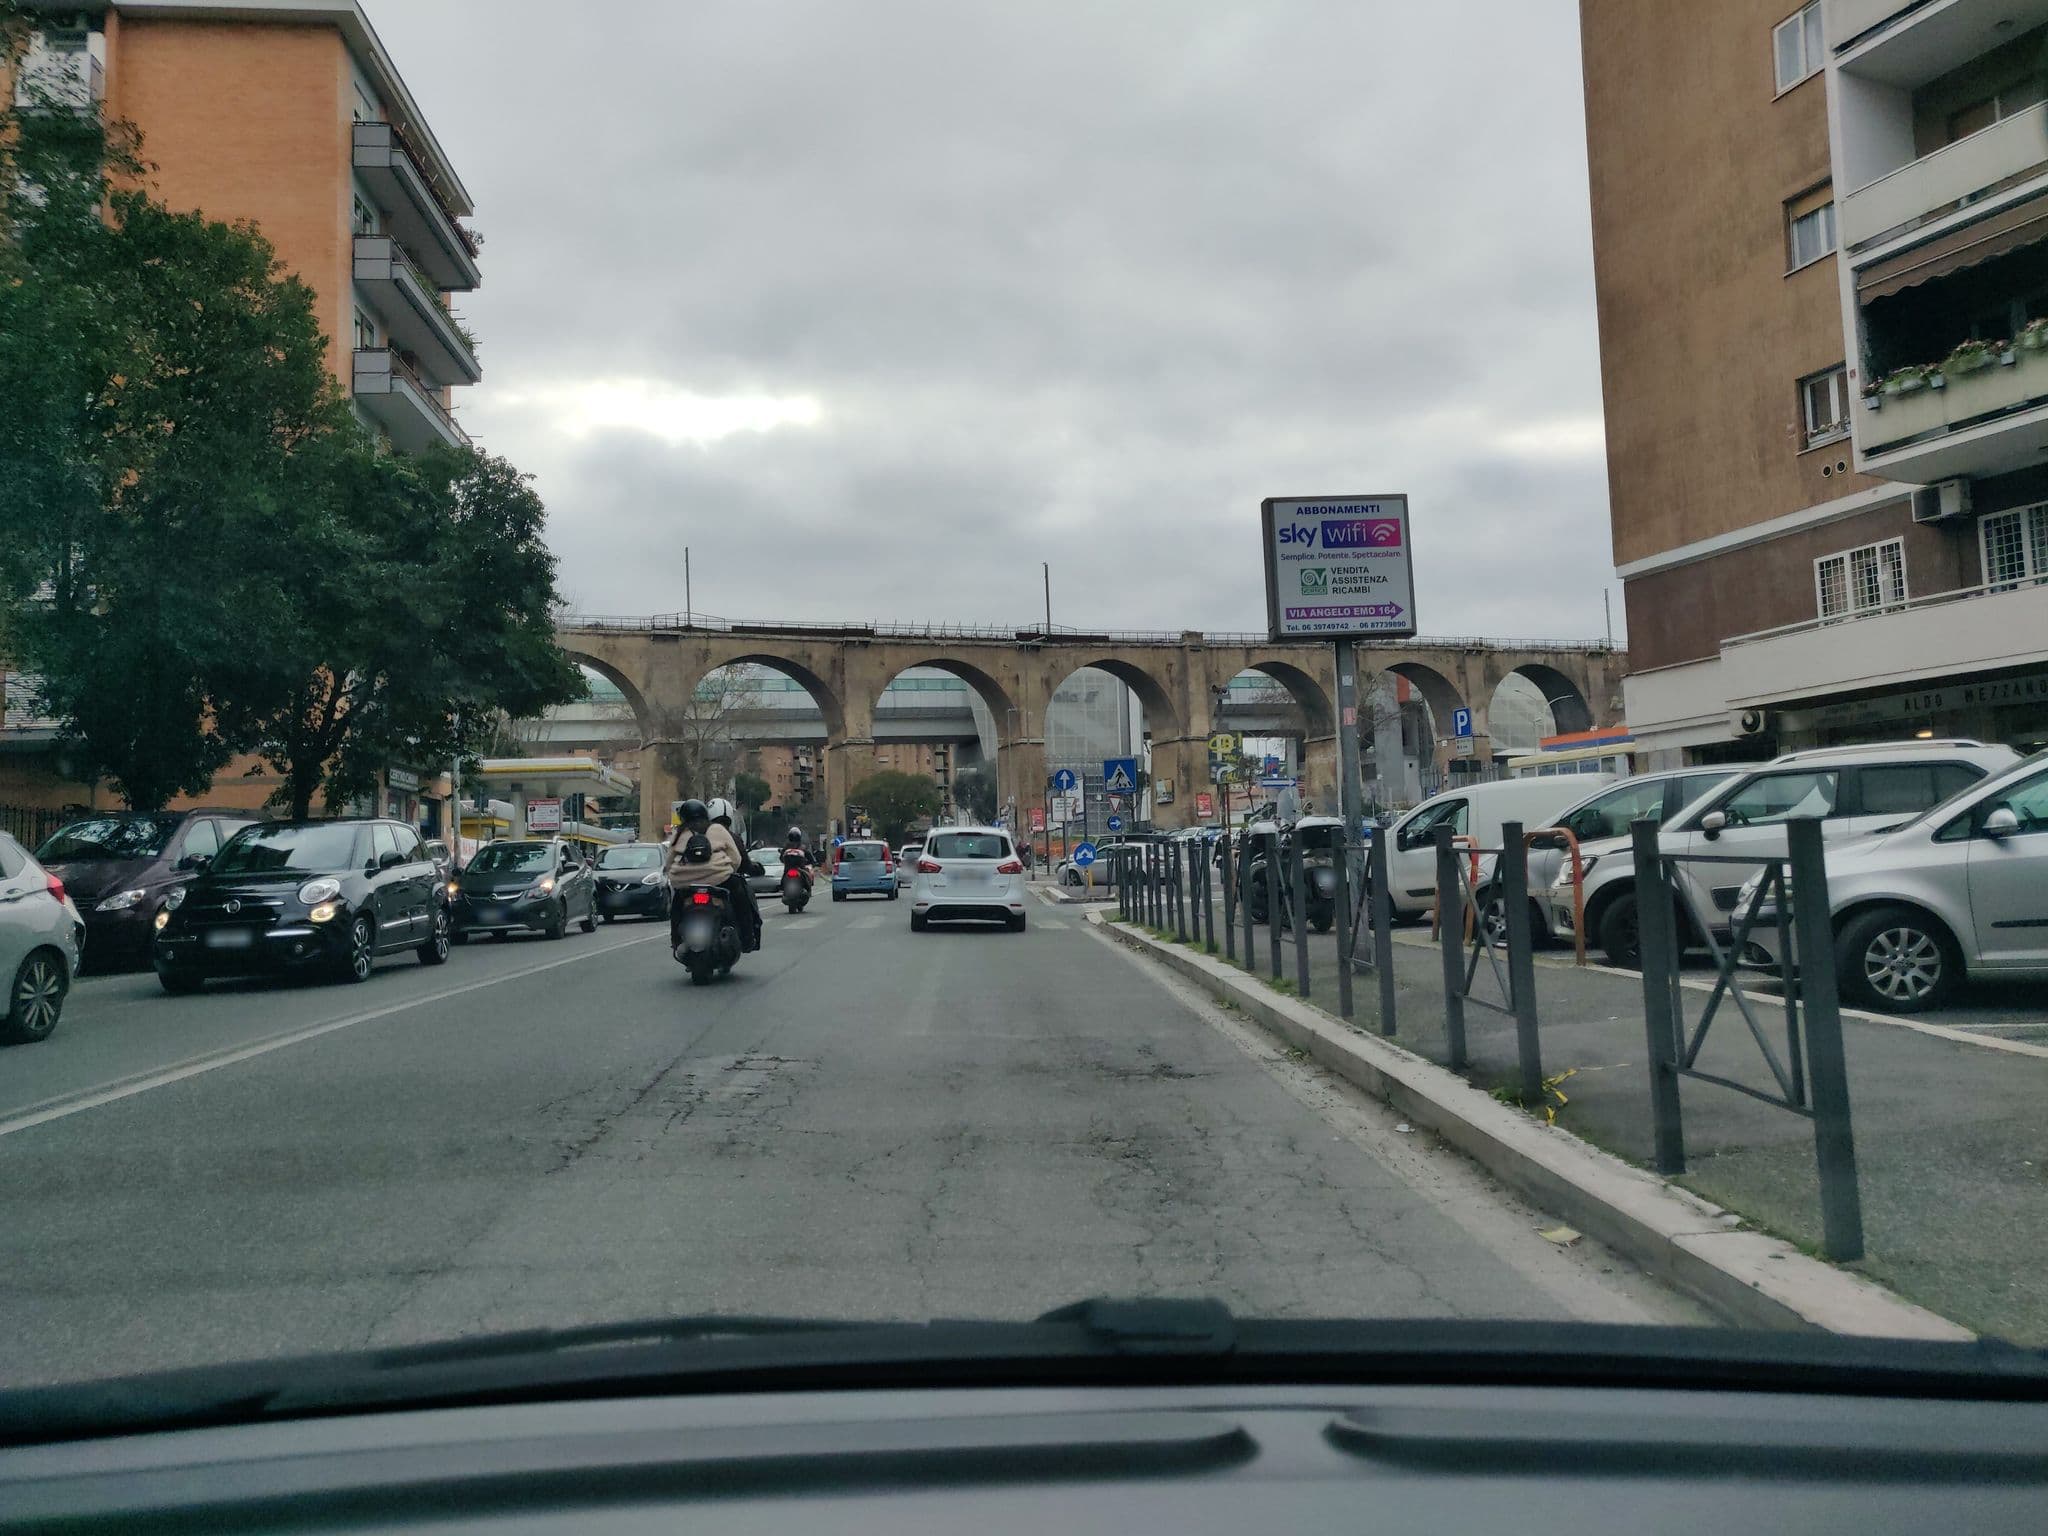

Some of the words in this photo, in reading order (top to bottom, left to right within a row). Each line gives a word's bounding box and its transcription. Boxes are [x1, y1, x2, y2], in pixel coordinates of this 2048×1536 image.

[1296, 504, 1380, 516] ABBONAMENTI
[1279, 523, 1317, 548] sky
[1327, 522, 1367, 543] wifi
[1280, 552, 1316, 563] Semplice.
[1318, 551, 1350, 561] Potente.
[1331, 566, 1370, 575] VENDITA
[1331, 575, 1389, 585] ASSISTENZA
[1332, 585, 1371, 595] RICAMBI
[1288, 608, 1308, 618] VIA
[1309, 606, 1351, 617] ANGELO
[1353, 606, 1376, 616] EMO
[1378, 605, 1397, 615] 164
[1286, 624, 1300, 632] Tel.
[1903, 693, 1943, 713] ALDO
[1456, 710, 1468, 735] P
